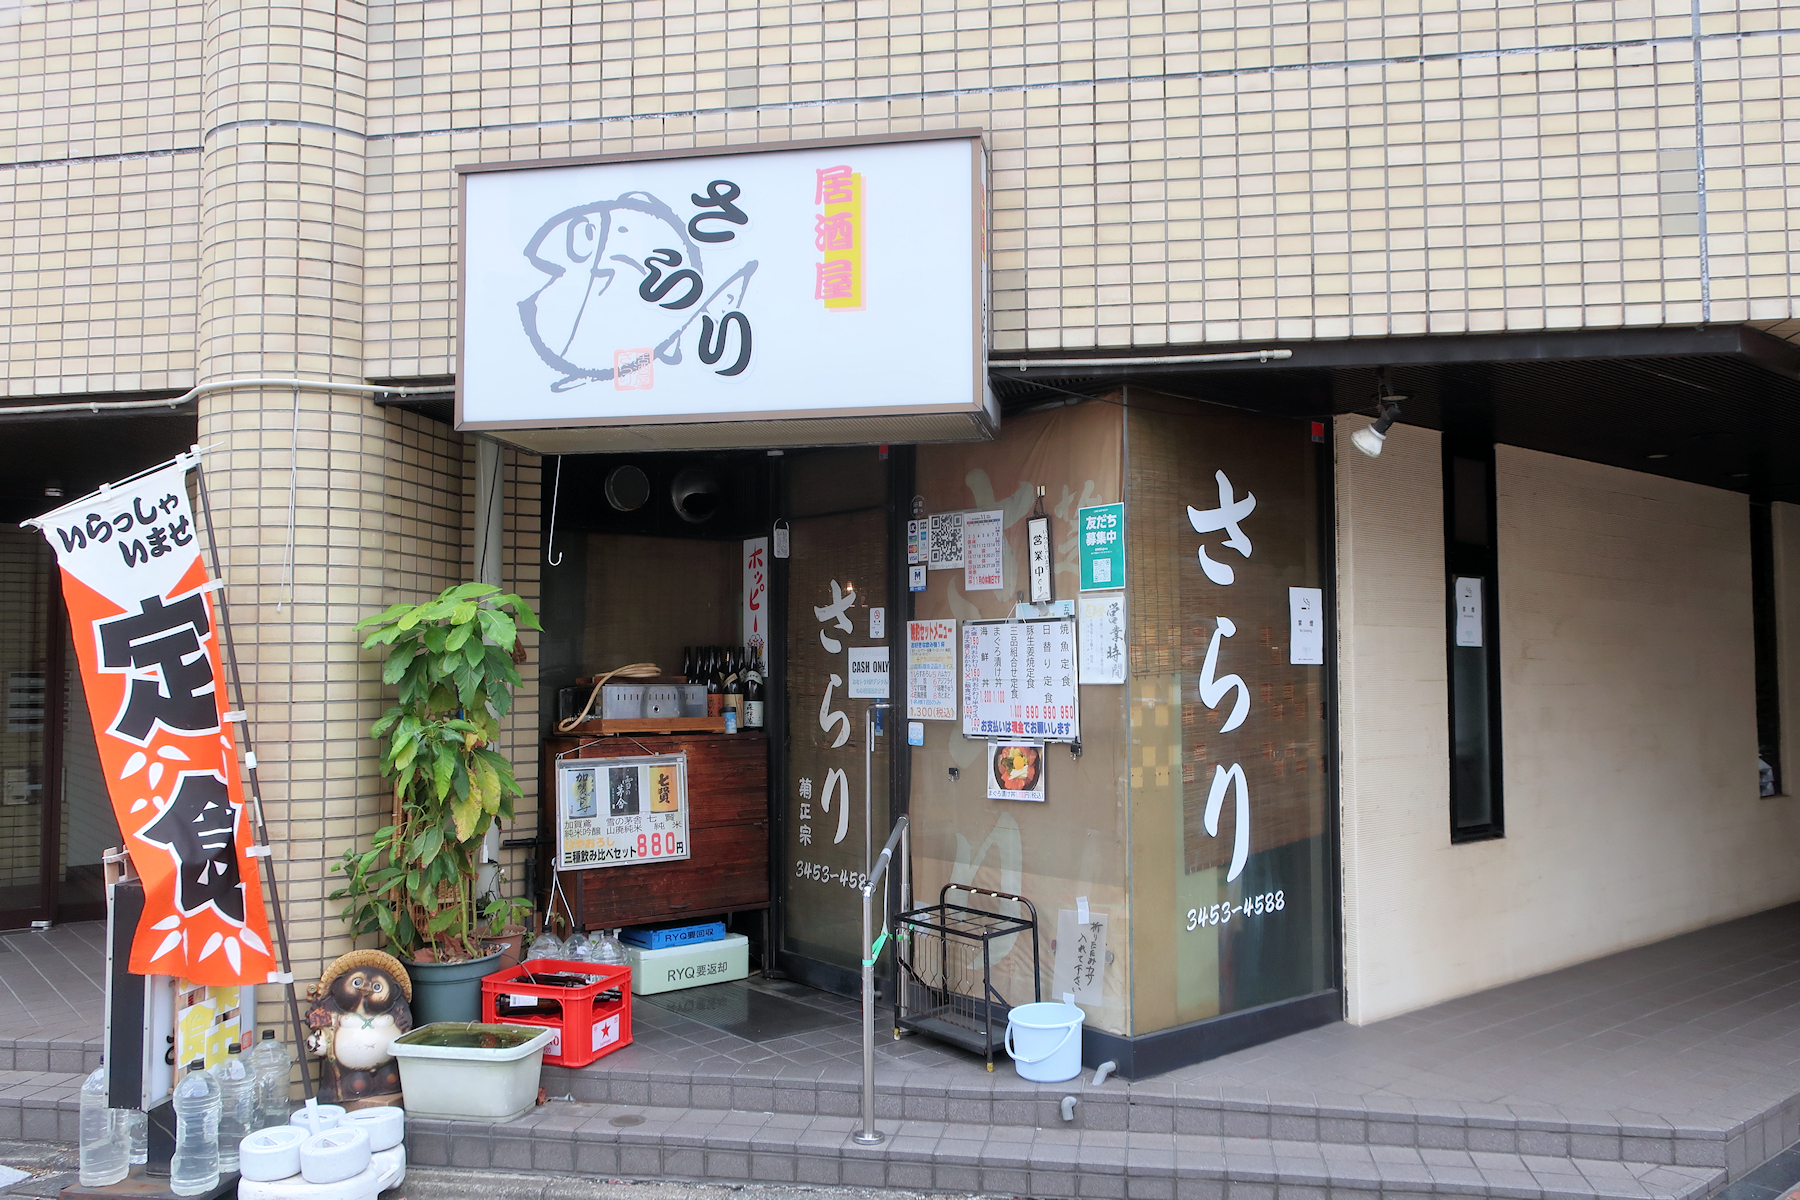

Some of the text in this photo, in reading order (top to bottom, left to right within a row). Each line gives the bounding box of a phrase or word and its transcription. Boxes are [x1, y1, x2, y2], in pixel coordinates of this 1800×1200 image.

[815, 164, 854, 300] 居酒屋
[639, 179, 752, 376] さらり
[57, 493, 180, 554] いらっしゃ
[119, 515, 194, 570] いませ
[1086, 514, 1117, 530] 友だち
[1086, 530, 1117, 546] 募集中
[749, 543, 765, 633] ホッピー
[852, 661, 890, 673] CASH ONLY
[980, 627, 989, 687] 海鮮丼
[994, 627, 1002, 688] まぐろ漬け丼
[1010, 626, 1018, 699] 三品組合せ定食
[1026, 625, 1035, 689] 豚生姜焼定食
[1043, 624, 1053, 704] 日替り定食
[1060, 624, 1070, 687] 焼魚定食
[1186, 468, 1257, 883] さらり
[814, 578, 856, 844] さらり
[981, 720, 1070, 735] お支払いは現金でお願いします
[1026, 705, 1039, 719] 990
[1043, 706, 1056, 719] 990
[1061, 706, 1073, 719] 950
[97, 591, 247, 924] 定食
[564, 819, 592, 830] 加賀鳶
[564, 827, 601, 838] 純米吟醸
[606, 816, 642, 826] 雪の茅舎
[607, 824, 642, 835] 山廃純米
[799, 777, 812, 846] 菊正宗
[565, 837, 615, 850] ひやおろし
[565, 845, 636, 864] 三種飲み比べセット
[796, 860, 877, 892] 3453-458
[1185, 890, 1285, 931] 3453-4588
[665, 928, 714, 942] RYQ要回収
[1085, 922, 1103, 986] 折りたたみカサ
[667, 962, 728, 982] RYQ要返却
[1071, 933, 1087, 992] 入れて下さい
